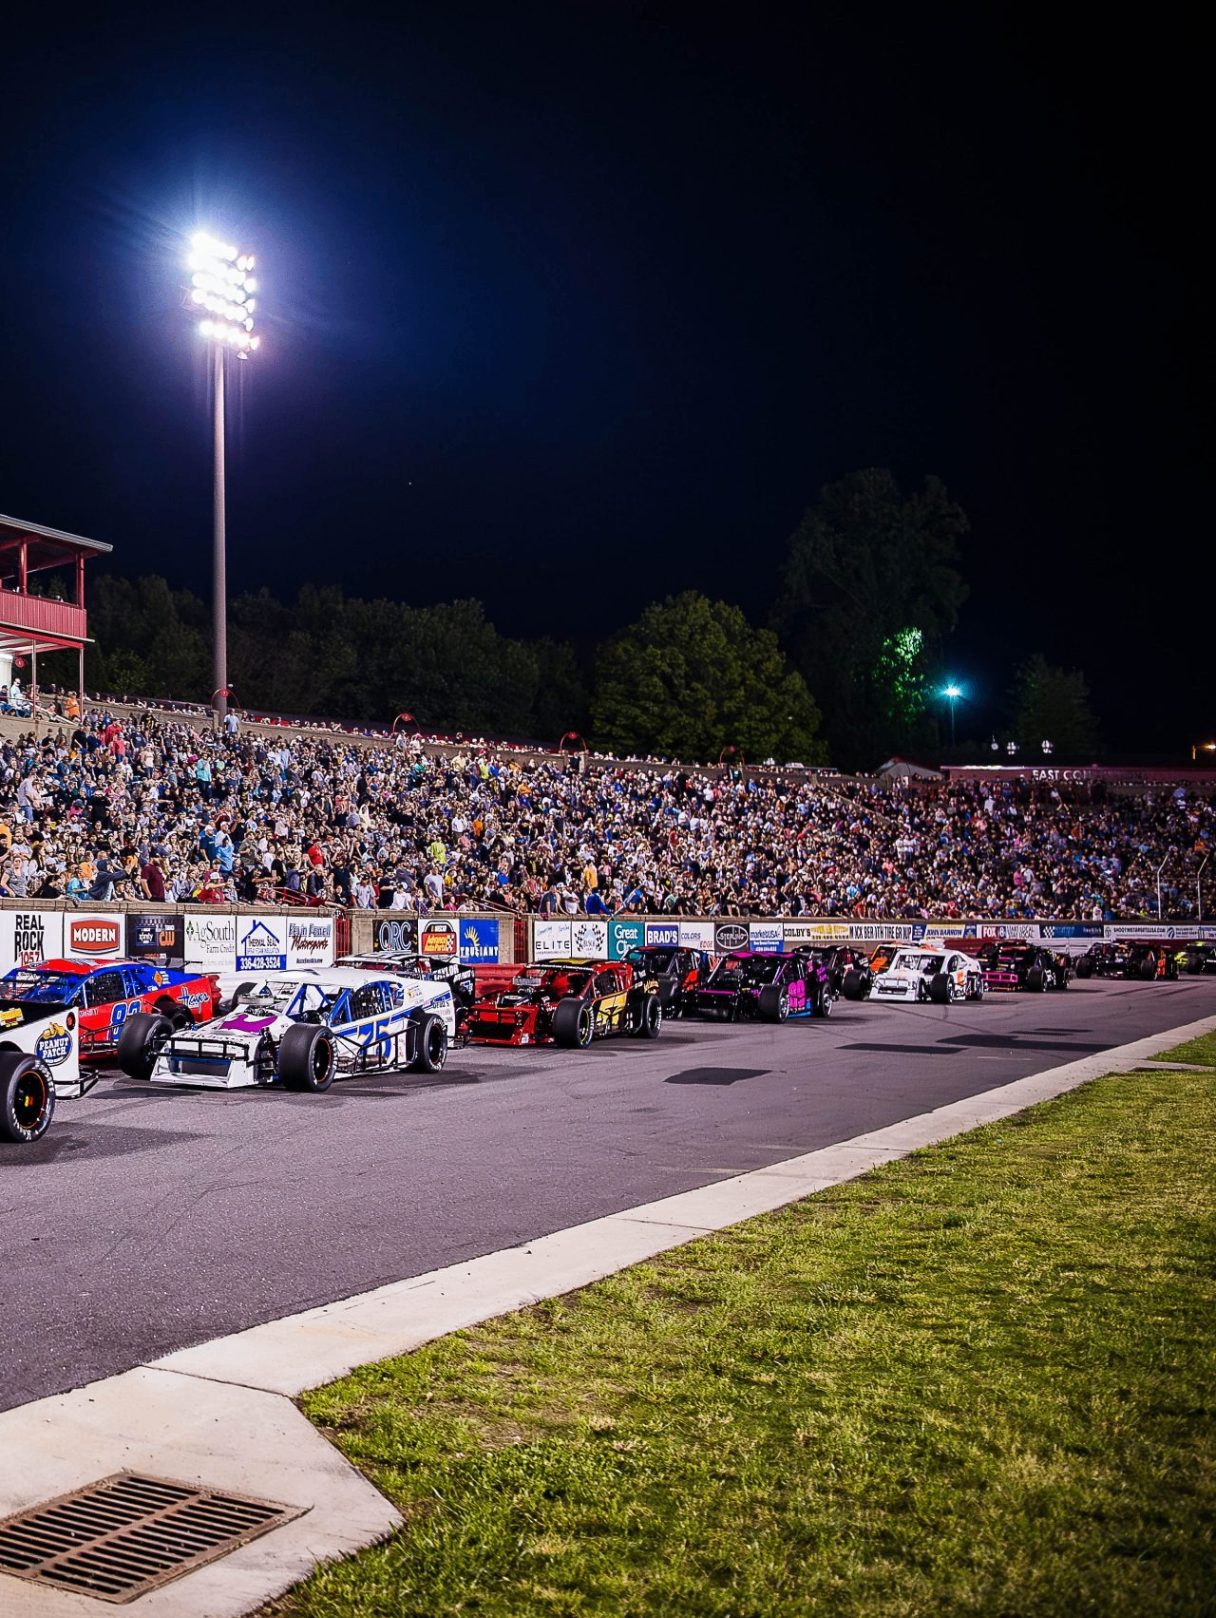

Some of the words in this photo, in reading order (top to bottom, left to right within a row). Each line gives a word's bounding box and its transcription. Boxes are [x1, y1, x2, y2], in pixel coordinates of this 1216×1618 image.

[1032, 769, 1060, 781] EAST
[15, 914, 45, 930] REAL
[73, 928, 116, 942] MODERN
[193, 920, 235, 949] AgSouth
[379, 921, 412, 951] QRC
[614, 924, 639, 940] Great
[647, 930, 678, 944] BRAD'S
[784, 927, 811, 938] COLBY'S
[983, 926, 997, 938] FOX
[14, 930, 45, 962] ROCK
[536, 940, 570, 950] ELITE
[18, 951, 40, 966] 1057
[432, 963, 460, 981] TAYLOR
[38, 1036, 70, 1051] PEANUT
[42, 1045, 67, 1057] PATCH
